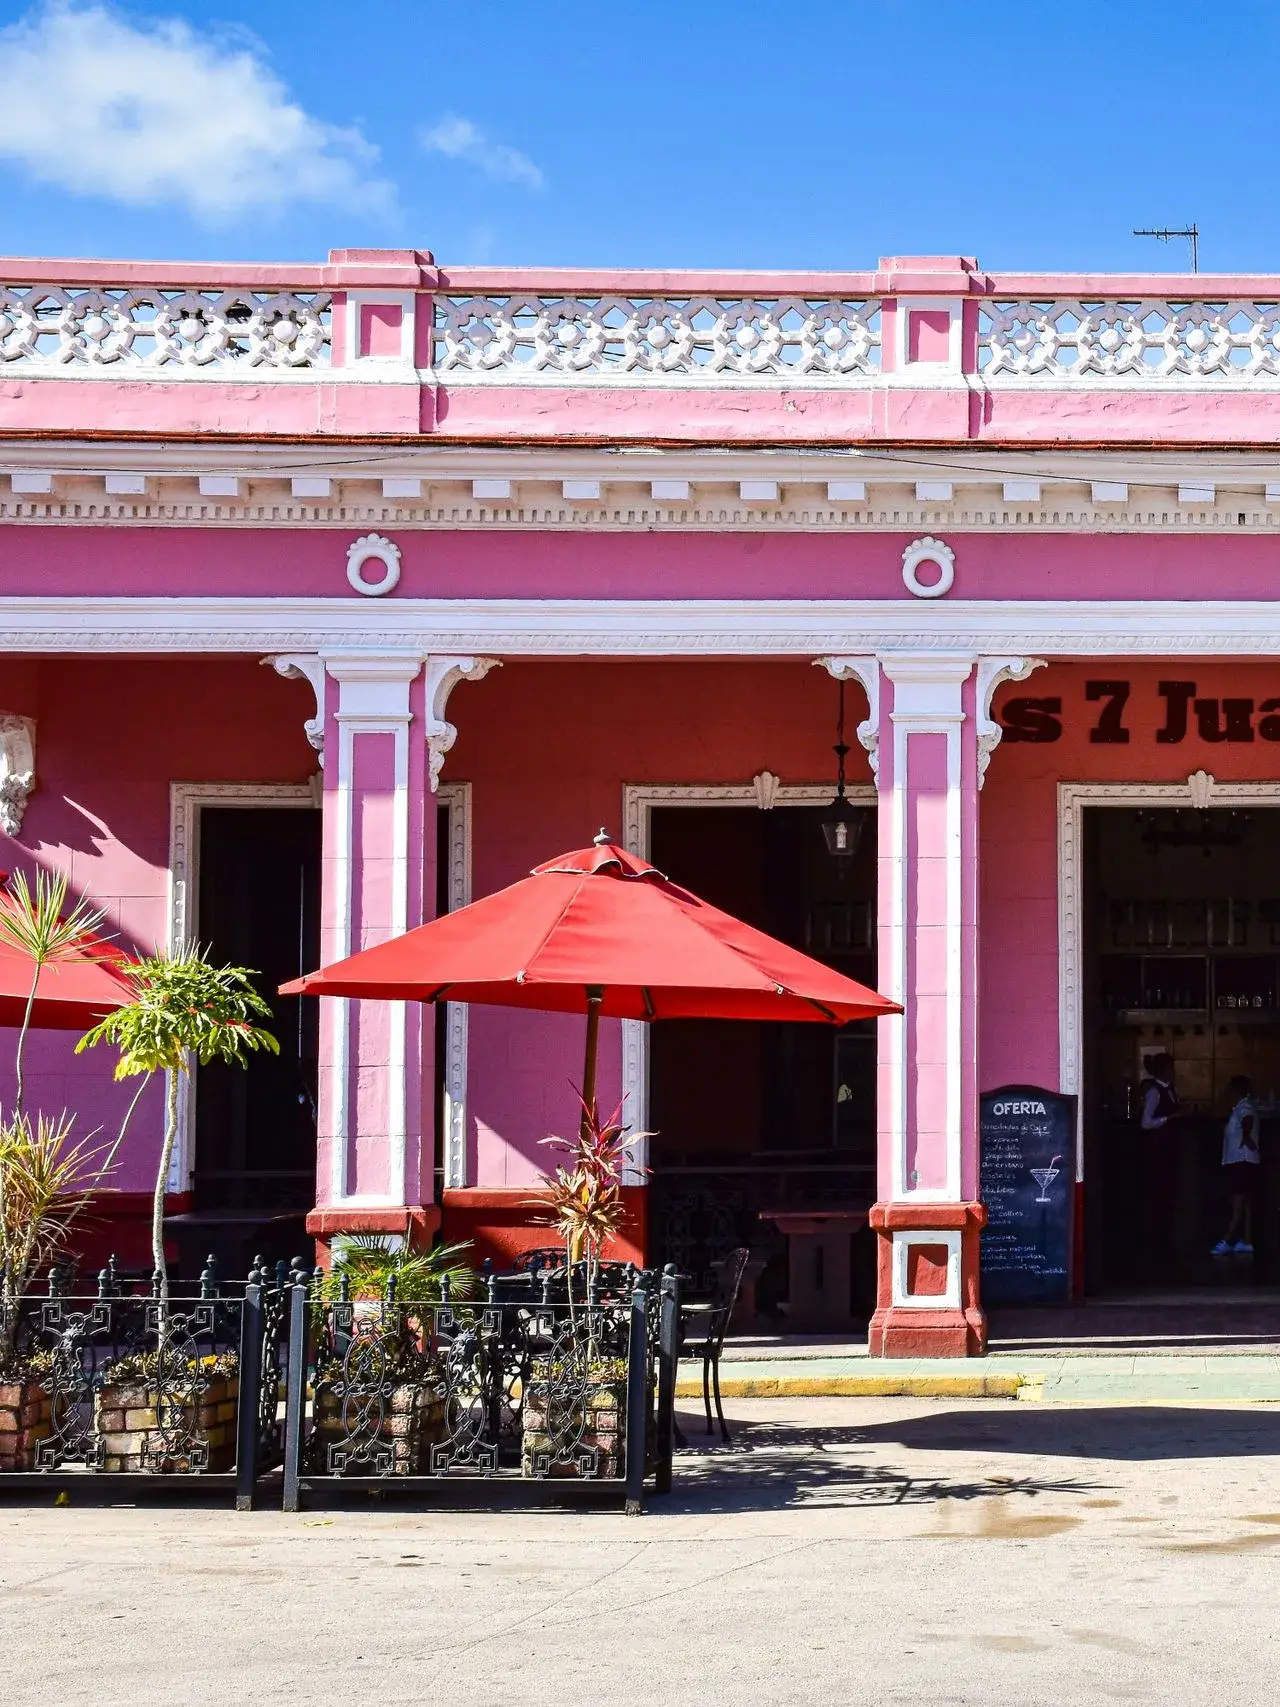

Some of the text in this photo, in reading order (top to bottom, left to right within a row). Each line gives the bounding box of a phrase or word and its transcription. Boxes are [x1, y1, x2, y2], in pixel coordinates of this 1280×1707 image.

[989, 697, 1062, 743] s
[1085, 680, 1130, 743] 7
[993, 1101, 1046, 1115] OFERTA
